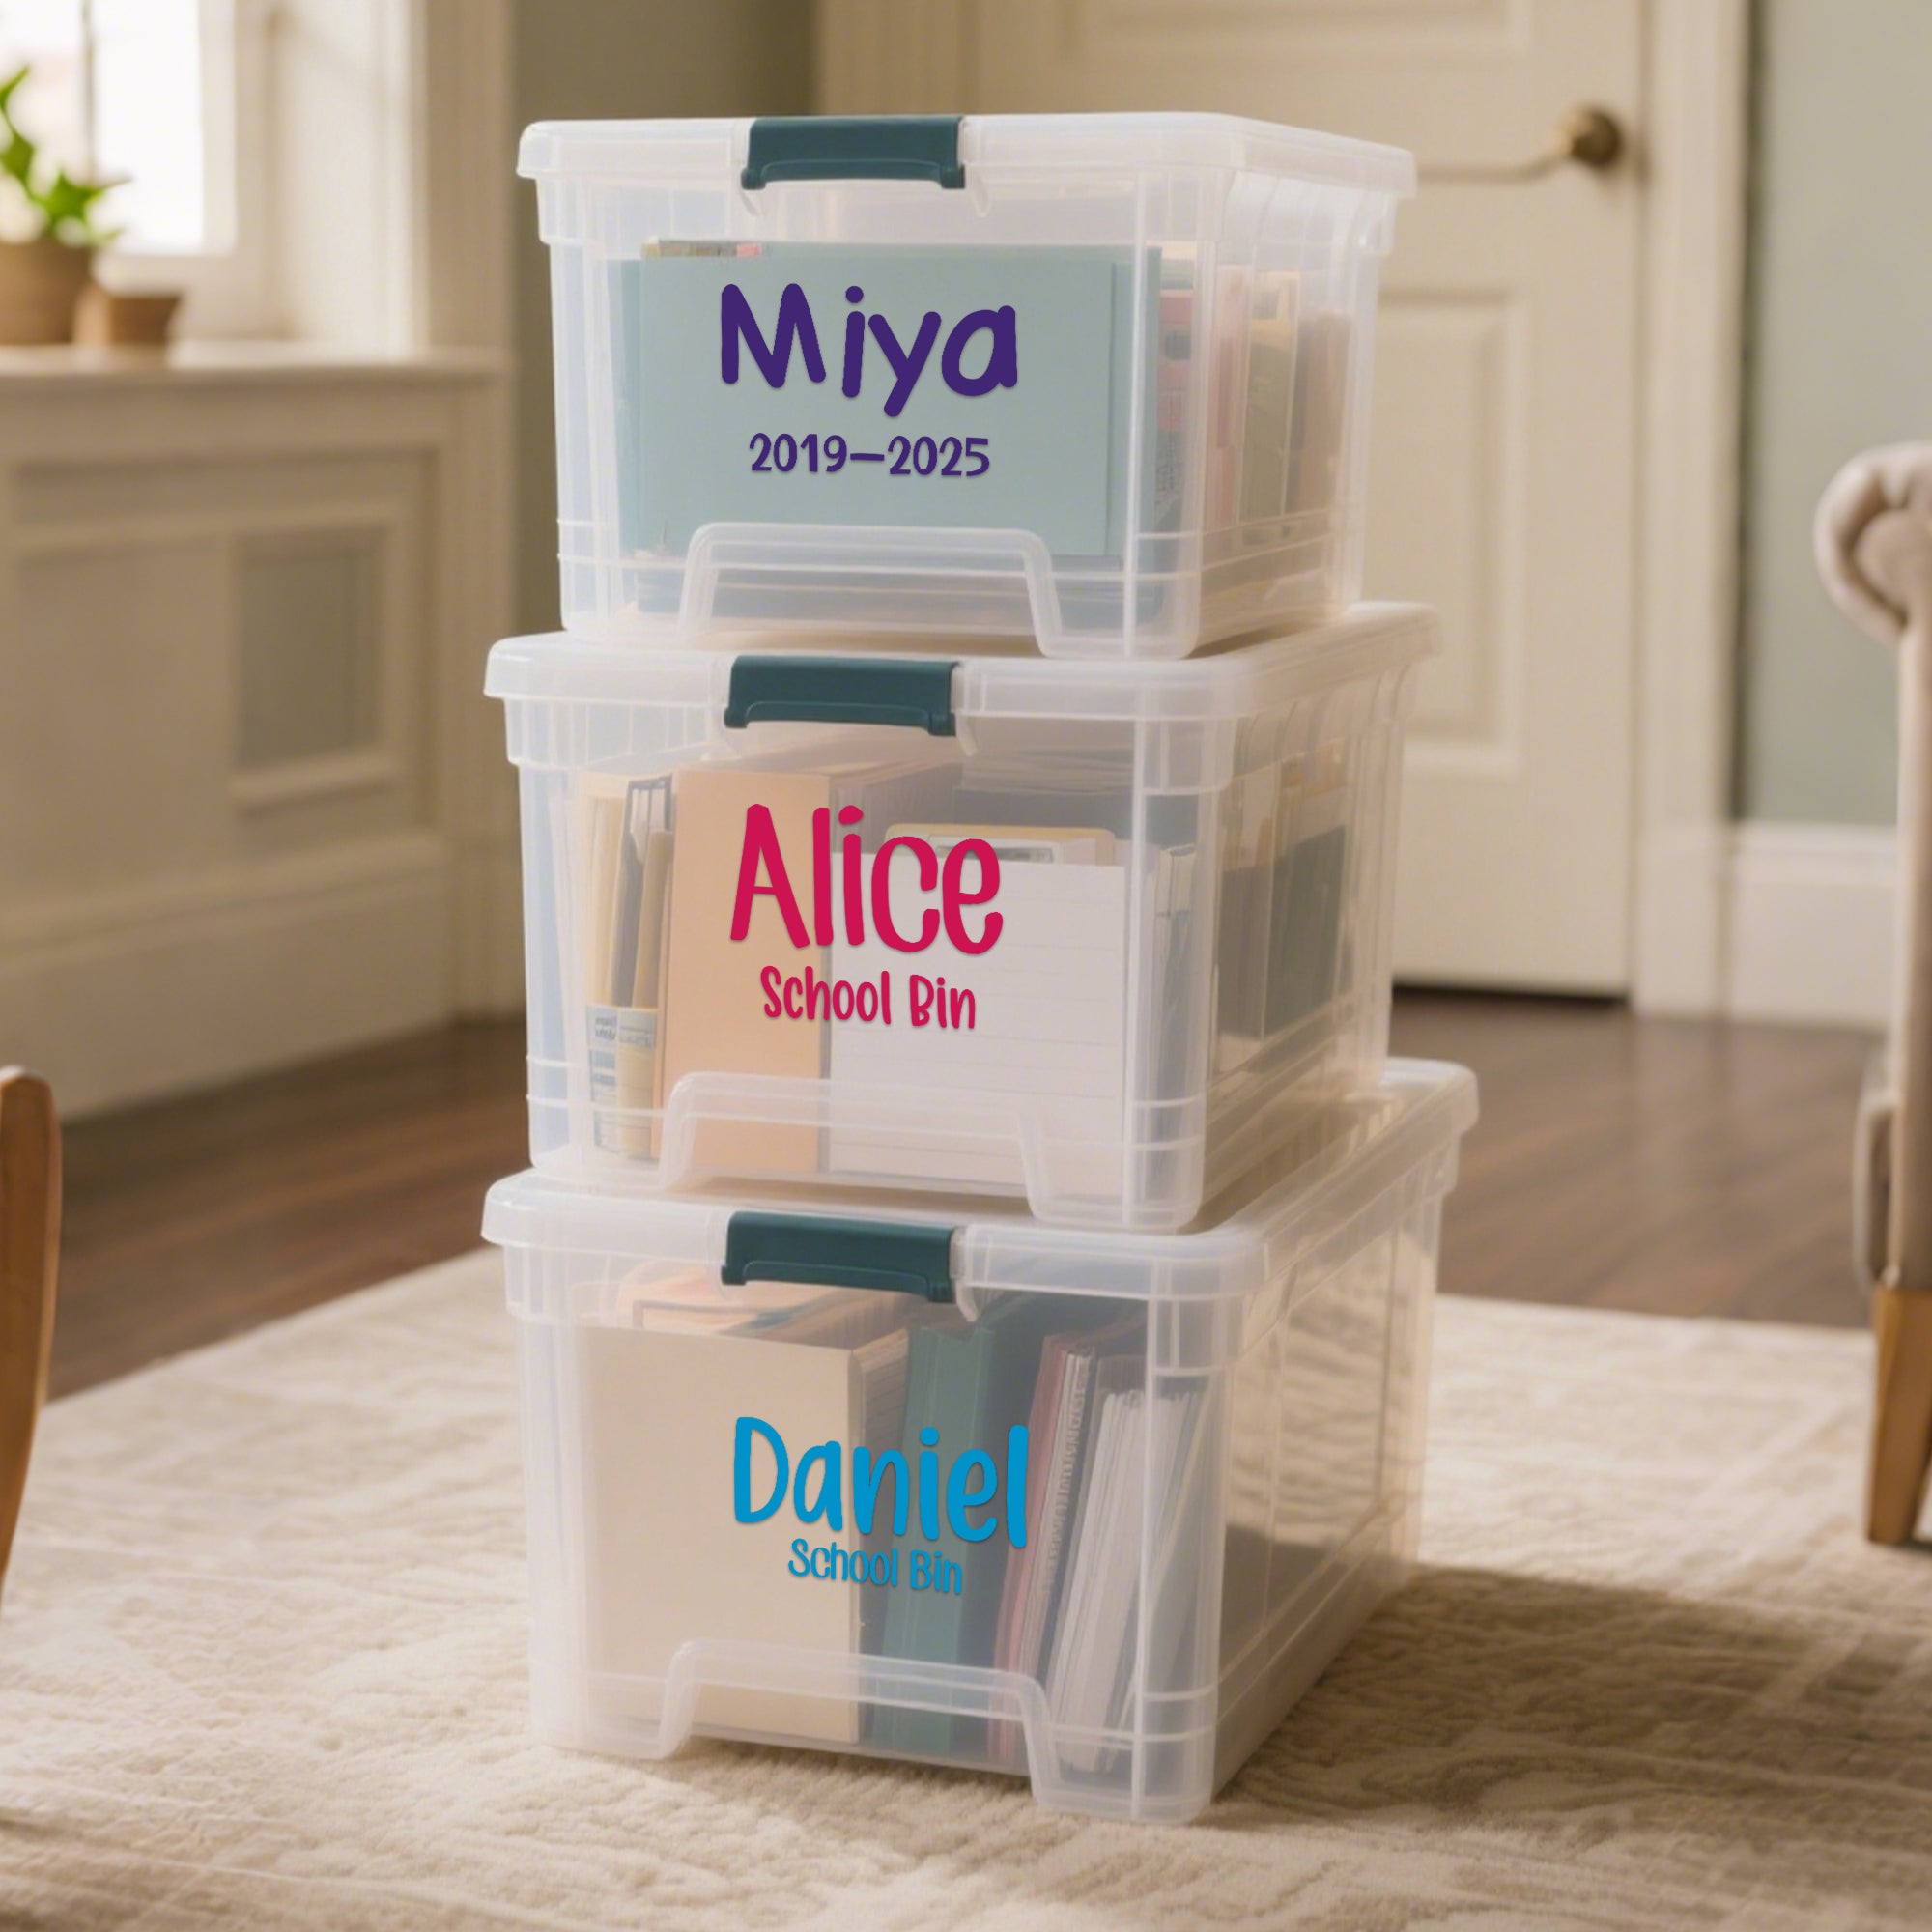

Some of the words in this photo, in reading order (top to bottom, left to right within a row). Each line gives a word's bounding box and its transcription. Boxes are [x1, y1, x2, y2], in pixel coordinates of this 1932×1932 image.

[719, 283, 1020, 417] Miya
[729, 803, 1005, 955] Alice
[759, 965, 892, 1026] School
[908, 974, 977, 1031] Bin
[732, 1416, 1030, 1549] Daniel
[787, 1538, 900, 1588] School
[908, 1548, 964, 1596] Bin
